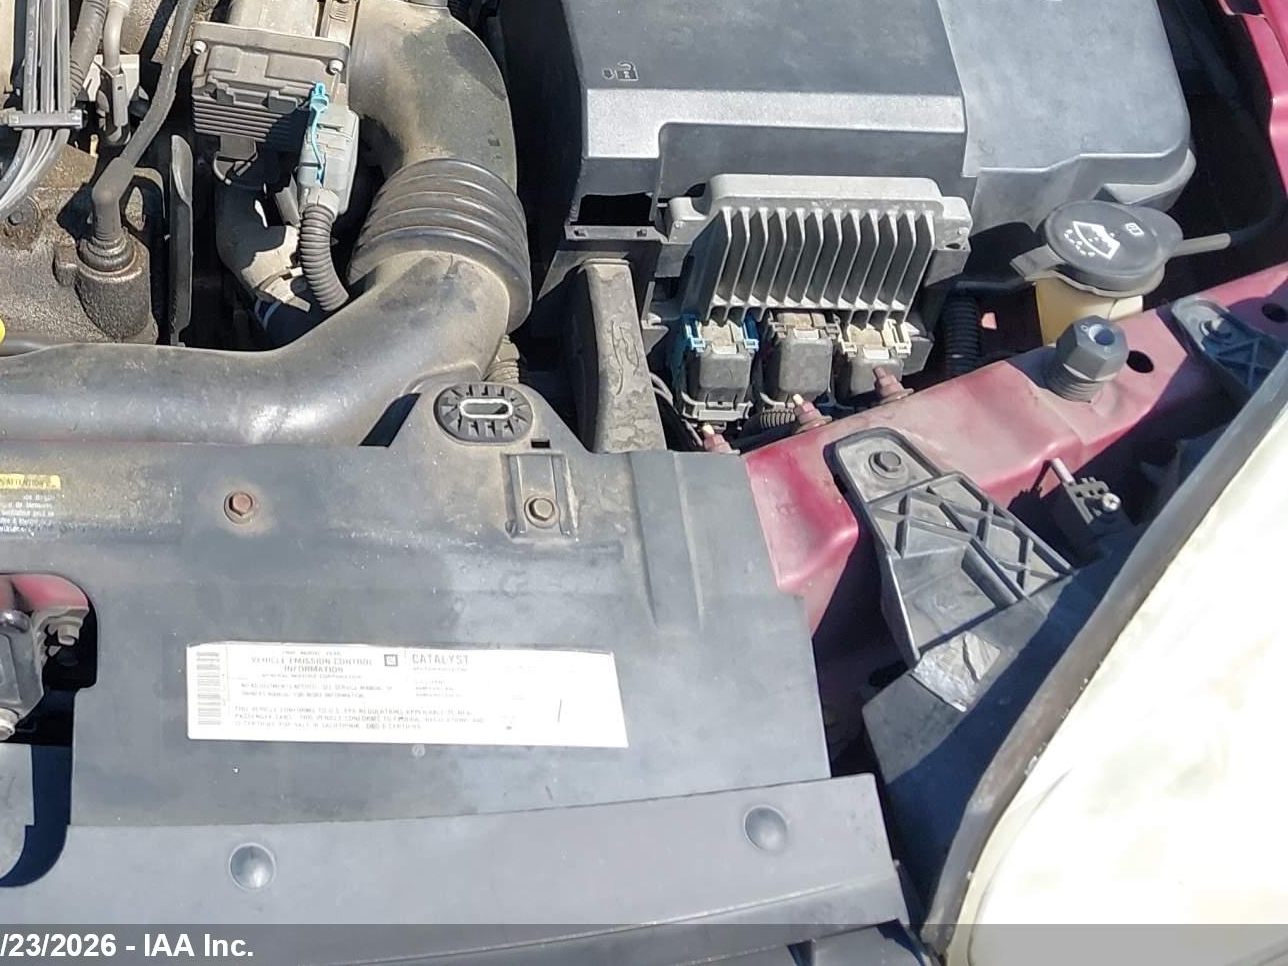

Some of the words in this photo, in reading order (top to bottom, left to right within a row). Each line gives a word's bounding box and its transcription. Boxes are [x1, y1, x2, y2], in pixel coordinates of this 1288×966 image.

[289, 657, 331, 665] EMISSION
[412, 653, 469, 665] CATALYST
[284, 665, 344, 673] INFORMATION
